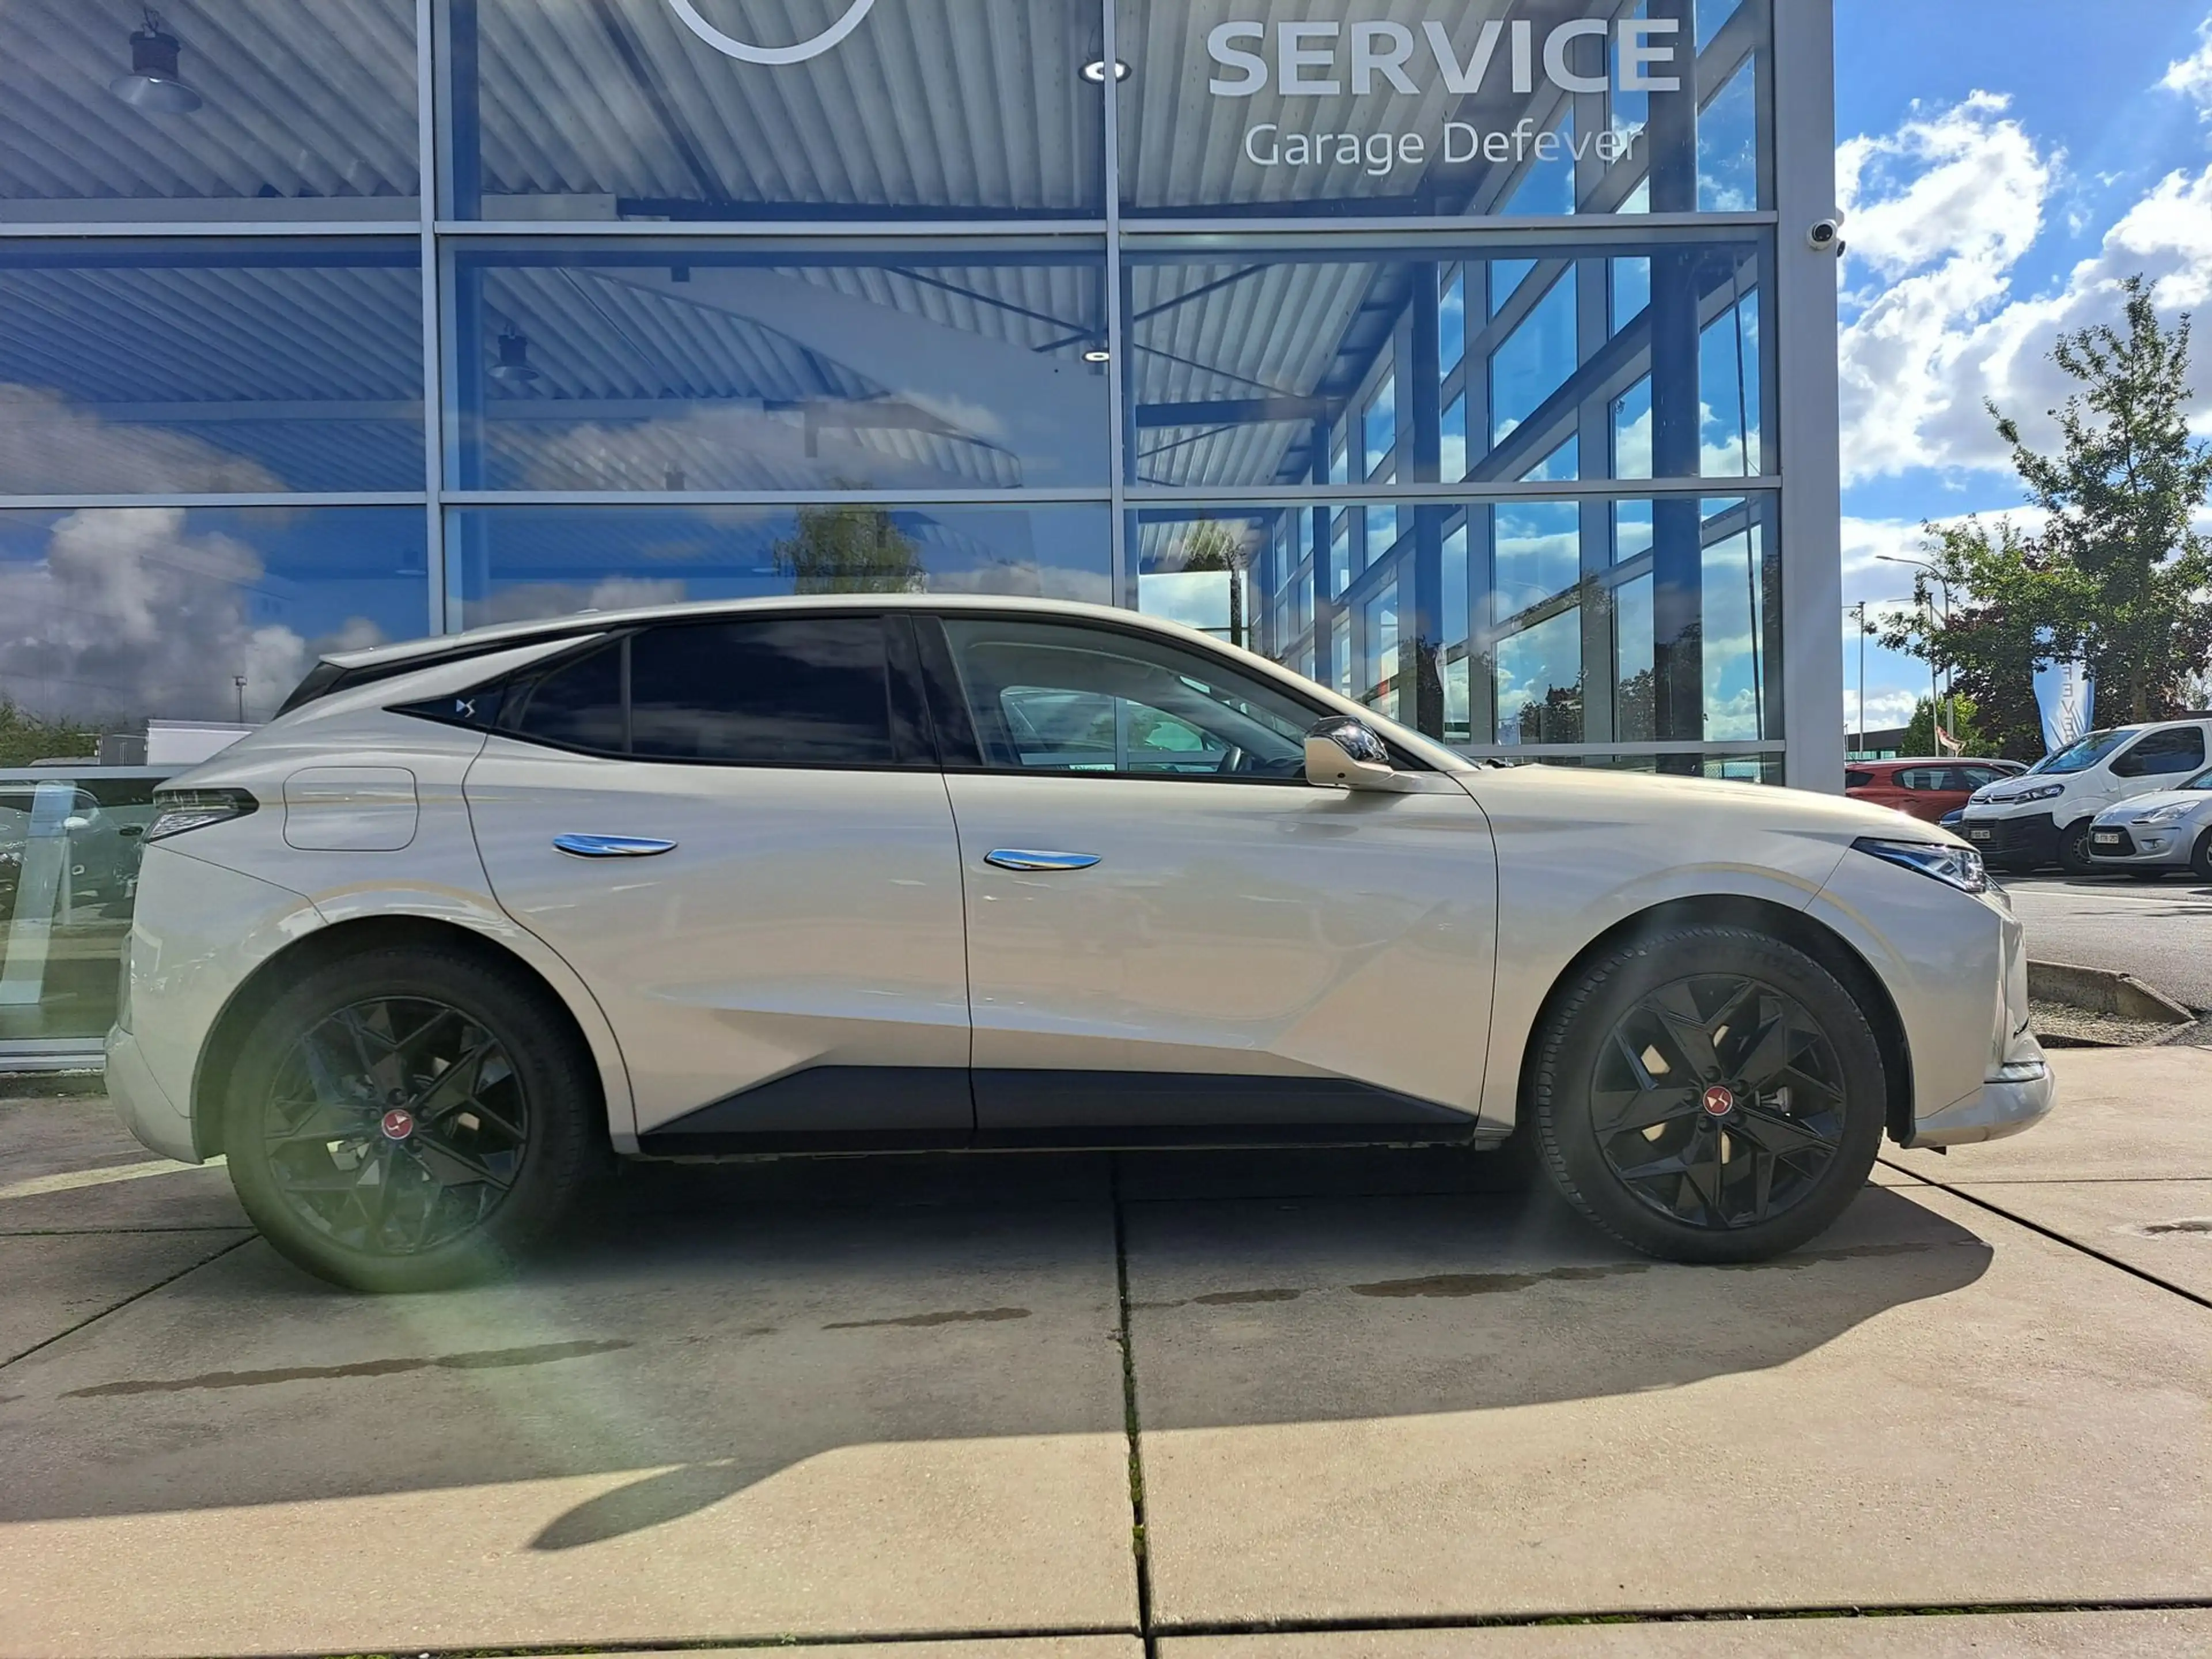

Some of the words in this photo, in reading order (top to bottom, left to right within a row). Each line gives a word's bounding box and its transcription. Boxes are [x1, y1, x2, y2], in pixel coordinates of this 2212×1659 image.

[1207, 18, 1680, 96] SERVICE
[1245, 123, 1425, 175] Garage
[1444, 118, 1643, 163] Defever
